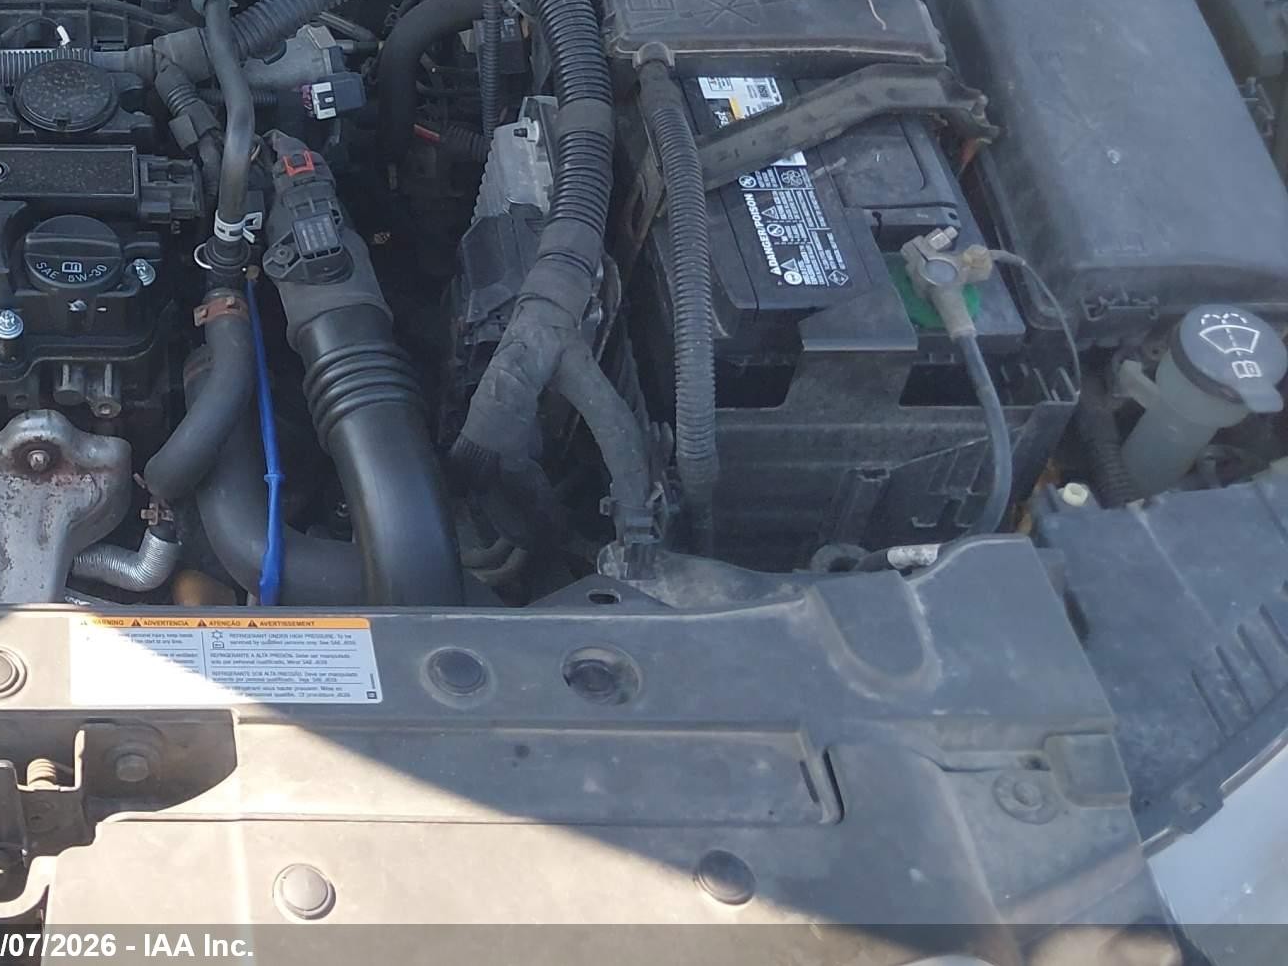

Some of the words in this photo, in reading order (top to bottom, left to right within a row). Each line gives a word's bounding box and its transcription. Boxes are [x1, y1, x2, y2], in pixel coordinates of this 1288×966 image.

[744, 193, 779, 267] DANGER/POISON
[36, 262, 59, 280] SAE
[67, 264, 108, 283] 5W-30
[143, 619, 189, 627] ADVERTENCIA
